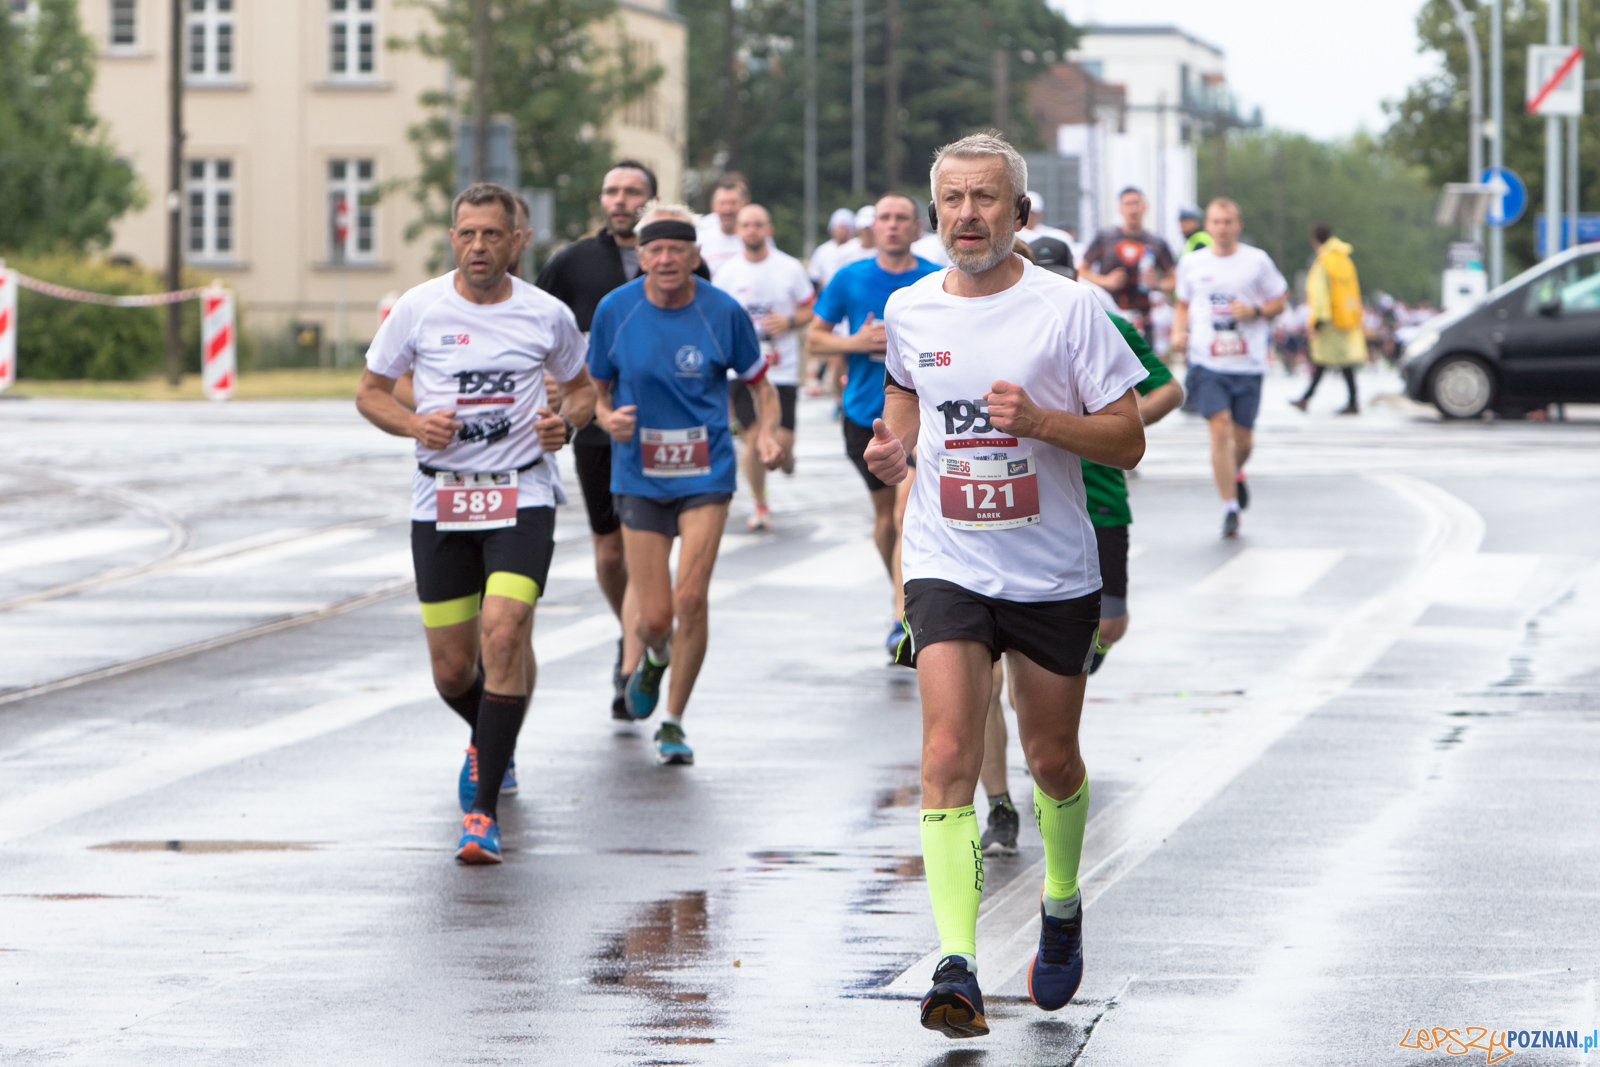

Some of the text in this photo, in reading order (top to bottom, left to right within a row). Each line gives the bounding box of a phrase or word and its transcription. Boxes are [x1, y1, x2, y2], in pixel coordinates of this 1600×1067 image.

[453, 370, 515, 394] 1956
[936, 399, 1004, 435] 195
[653, 444, 695, 464] 427
[452, 490, 503, 514] 589
[960, 483, 1015, 509] 121
